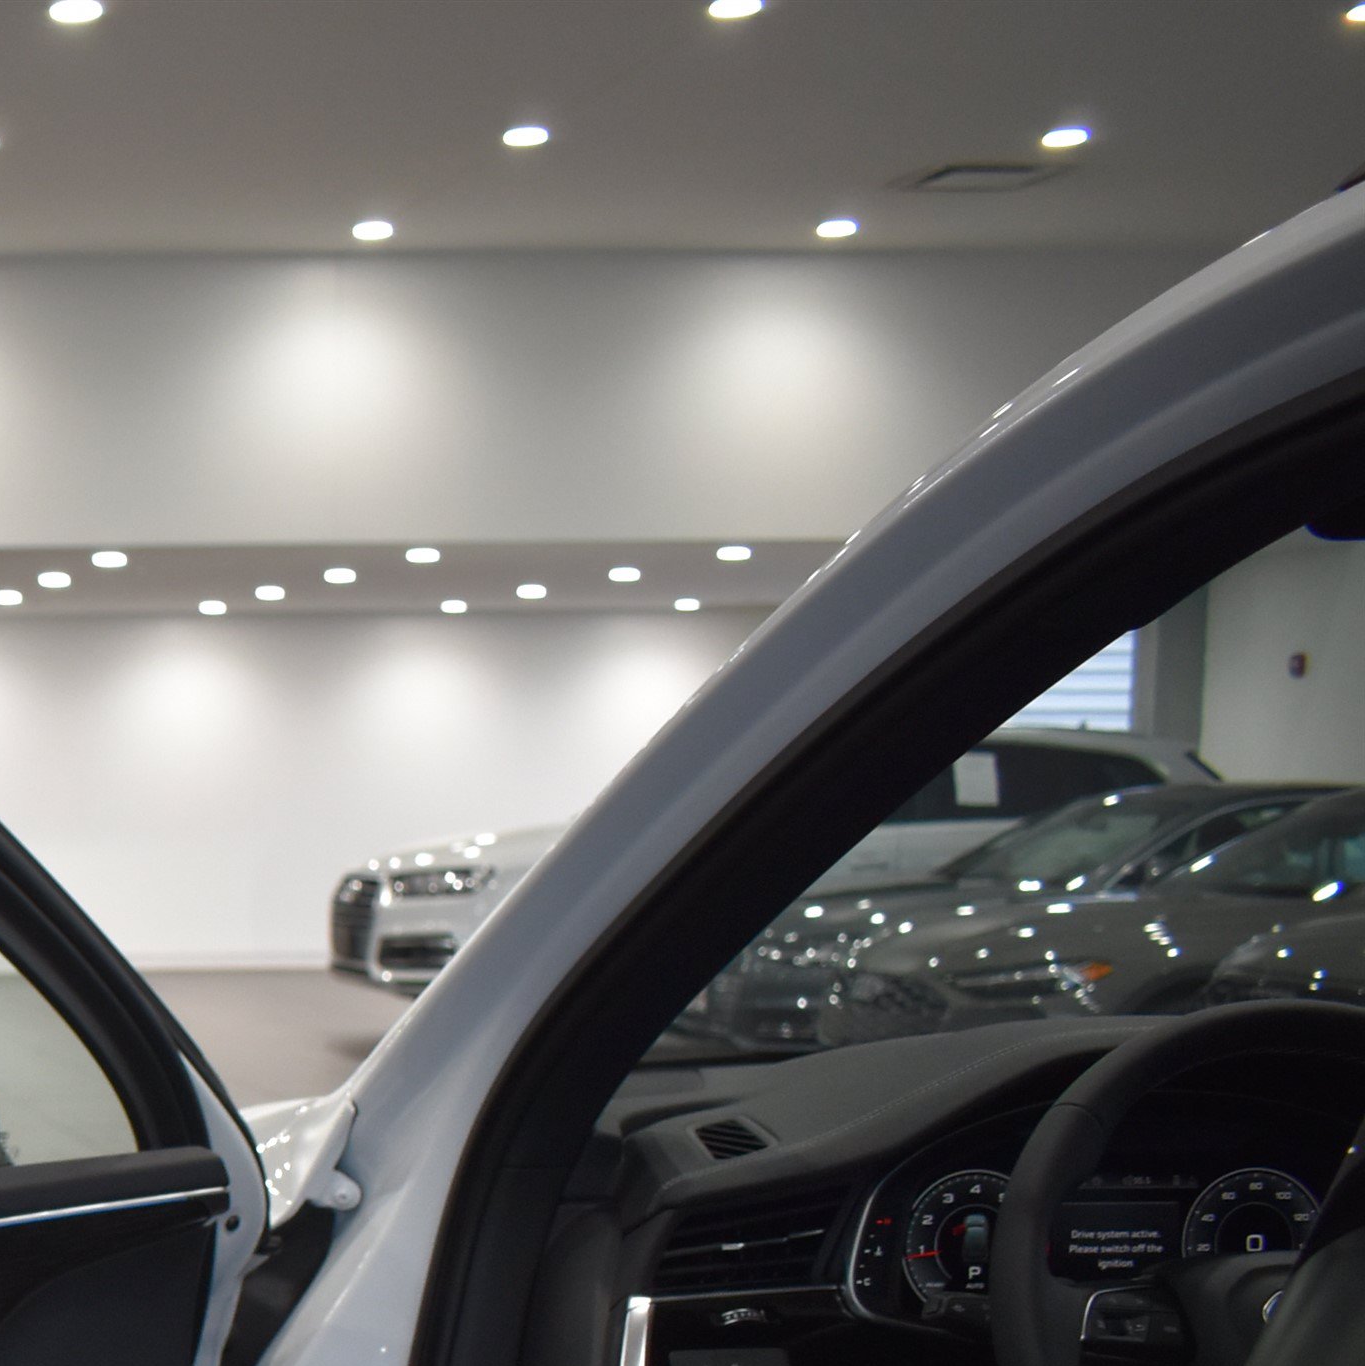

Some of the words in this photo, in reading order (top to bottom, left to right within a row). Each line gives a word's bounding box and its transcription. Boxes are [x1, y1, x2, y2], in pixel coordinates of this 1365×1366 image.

[970, 1184, 982, 1194] 4
[942, 1193, 955, 1204] 3
[921, 1215, 934, 1225] 2
[1071, 1230, 1095, 1239] Drive
[1097, 1231, 1129, 1240] system
[1069, 1244, 1098, 1253] Please
[968, 1266, 982, 1279] P
